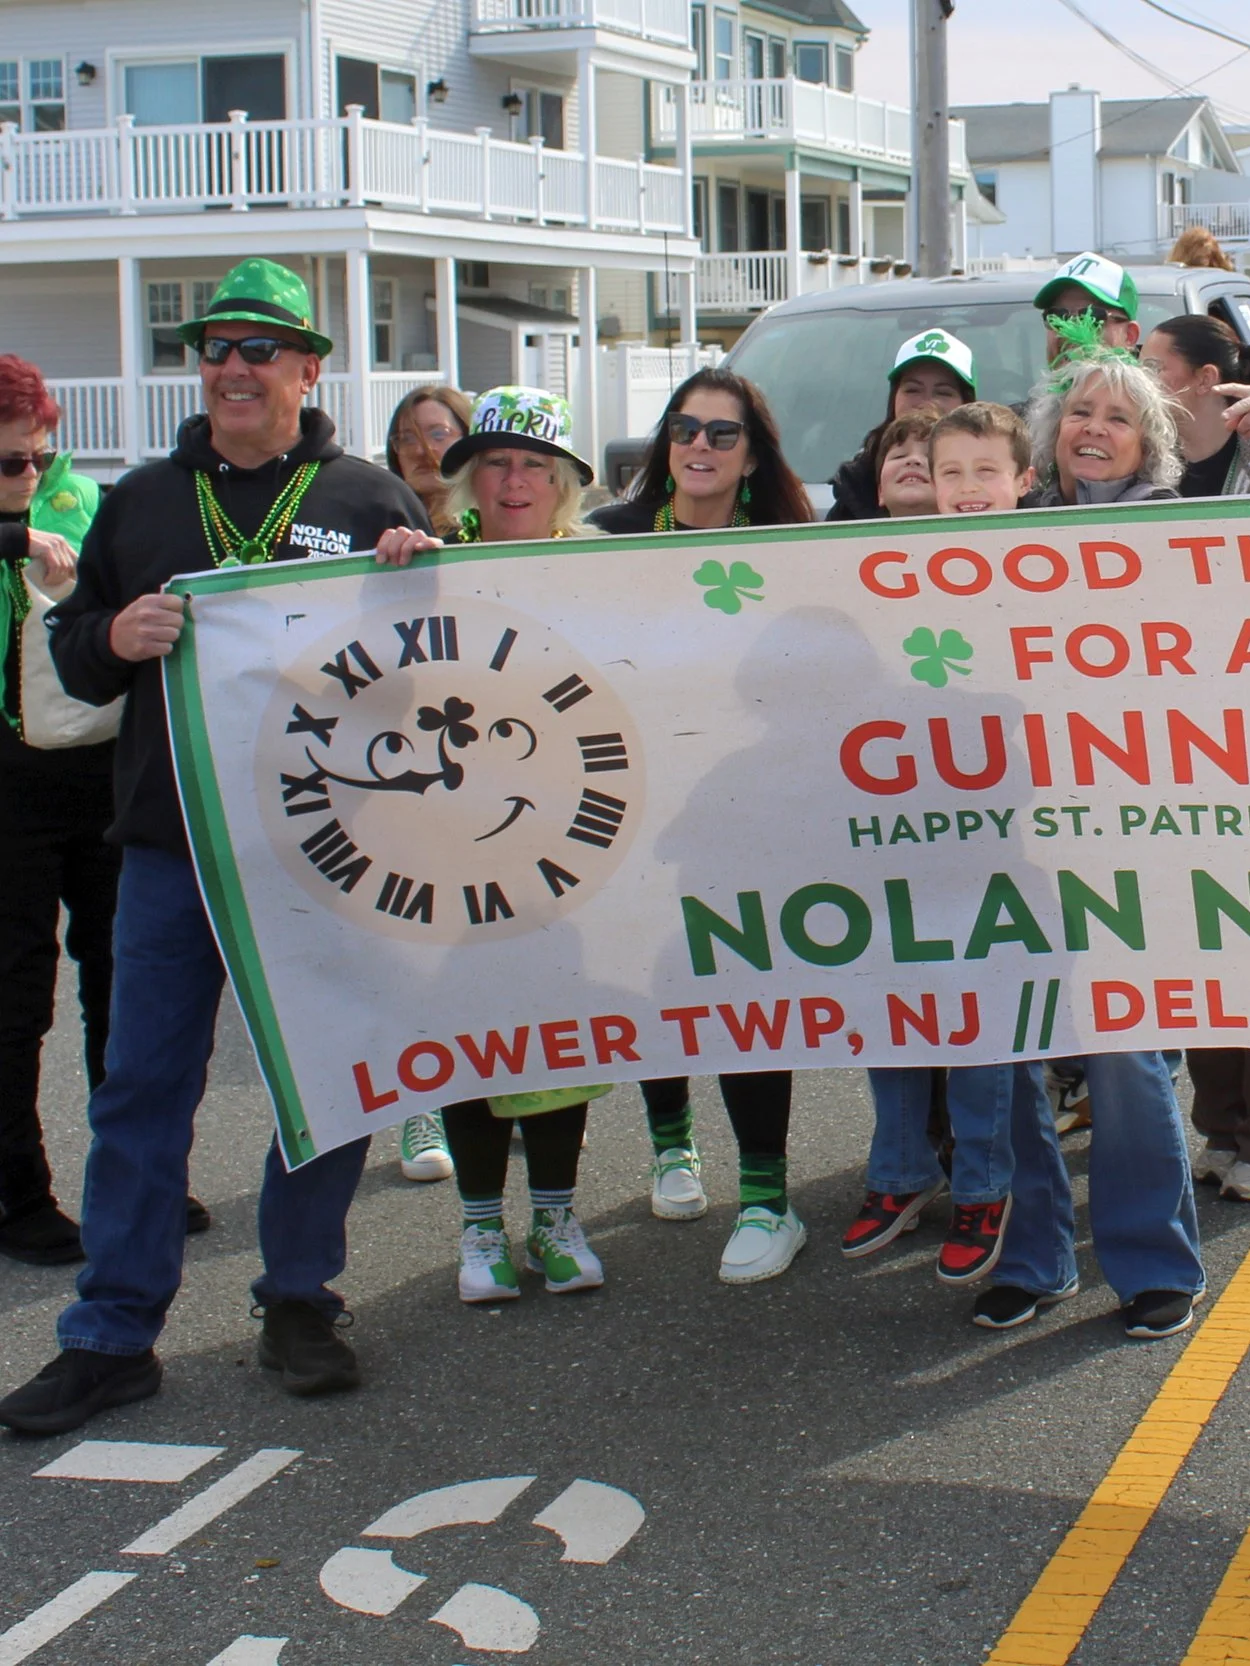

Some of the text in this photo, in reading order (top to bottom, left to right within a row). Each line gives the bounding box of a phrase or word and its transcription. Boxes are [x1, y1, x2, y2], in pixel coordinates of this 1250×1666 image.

[1067, 258, 1100, 277] VT
[289, 534, 350, 554] NATION
[291, 523, 351, 545] NOLAN
[859, 541, 1142, 599] GOOD
[393, 616, 459, 669] XII
[1010, 621, 1196, 680] FOR
[320, 640, 384, 700] XI
[542, 673, 593, 713] II
[285, 702, 339, 747] X
[576, 732, 629, 773] III
[848, 808, 1015, 848] HAPPY
[1033, 806, 1103, 838] ST.
[375, 871, 434, 924] VII
[536, 857, 580, 898] V
[462, 881, 515, 925] VI
[681, 869, 1144, 977] NOLAN
[353, 1015, 641, 1113] LOWER
[661, 997, 864, 1056] TWP,
[887, 992, 980, 1046] NJ
